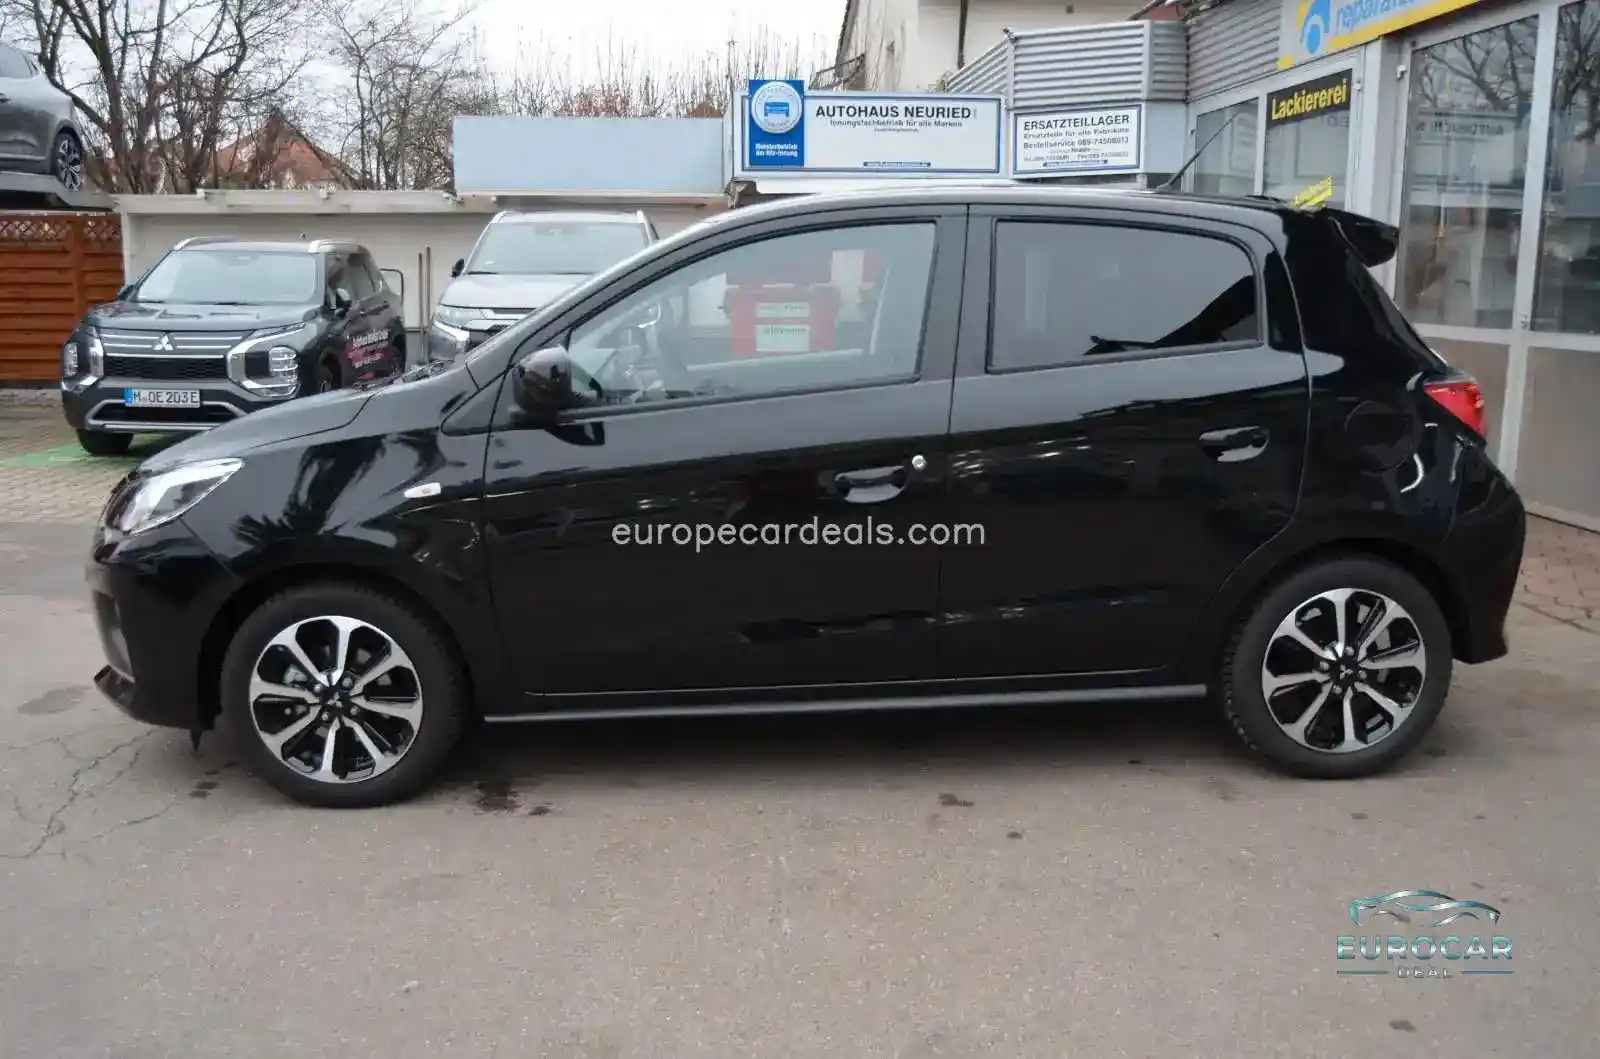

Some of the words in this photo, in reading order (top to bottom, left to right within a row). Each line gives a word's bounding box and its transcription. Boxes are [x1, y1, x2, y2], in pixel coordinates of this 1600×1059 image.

[1271, 78, 1348, 120] Lackiererei
[815, 105, 900, 118] AUTOHAUS
[903, 106, 972, 119] NEURIED
[906, 119, 916, 127] für
[1023, 115, 1130, 131] ERSATZTEILLAGER
[1023, 139, 1076, 149] Bestellservice
